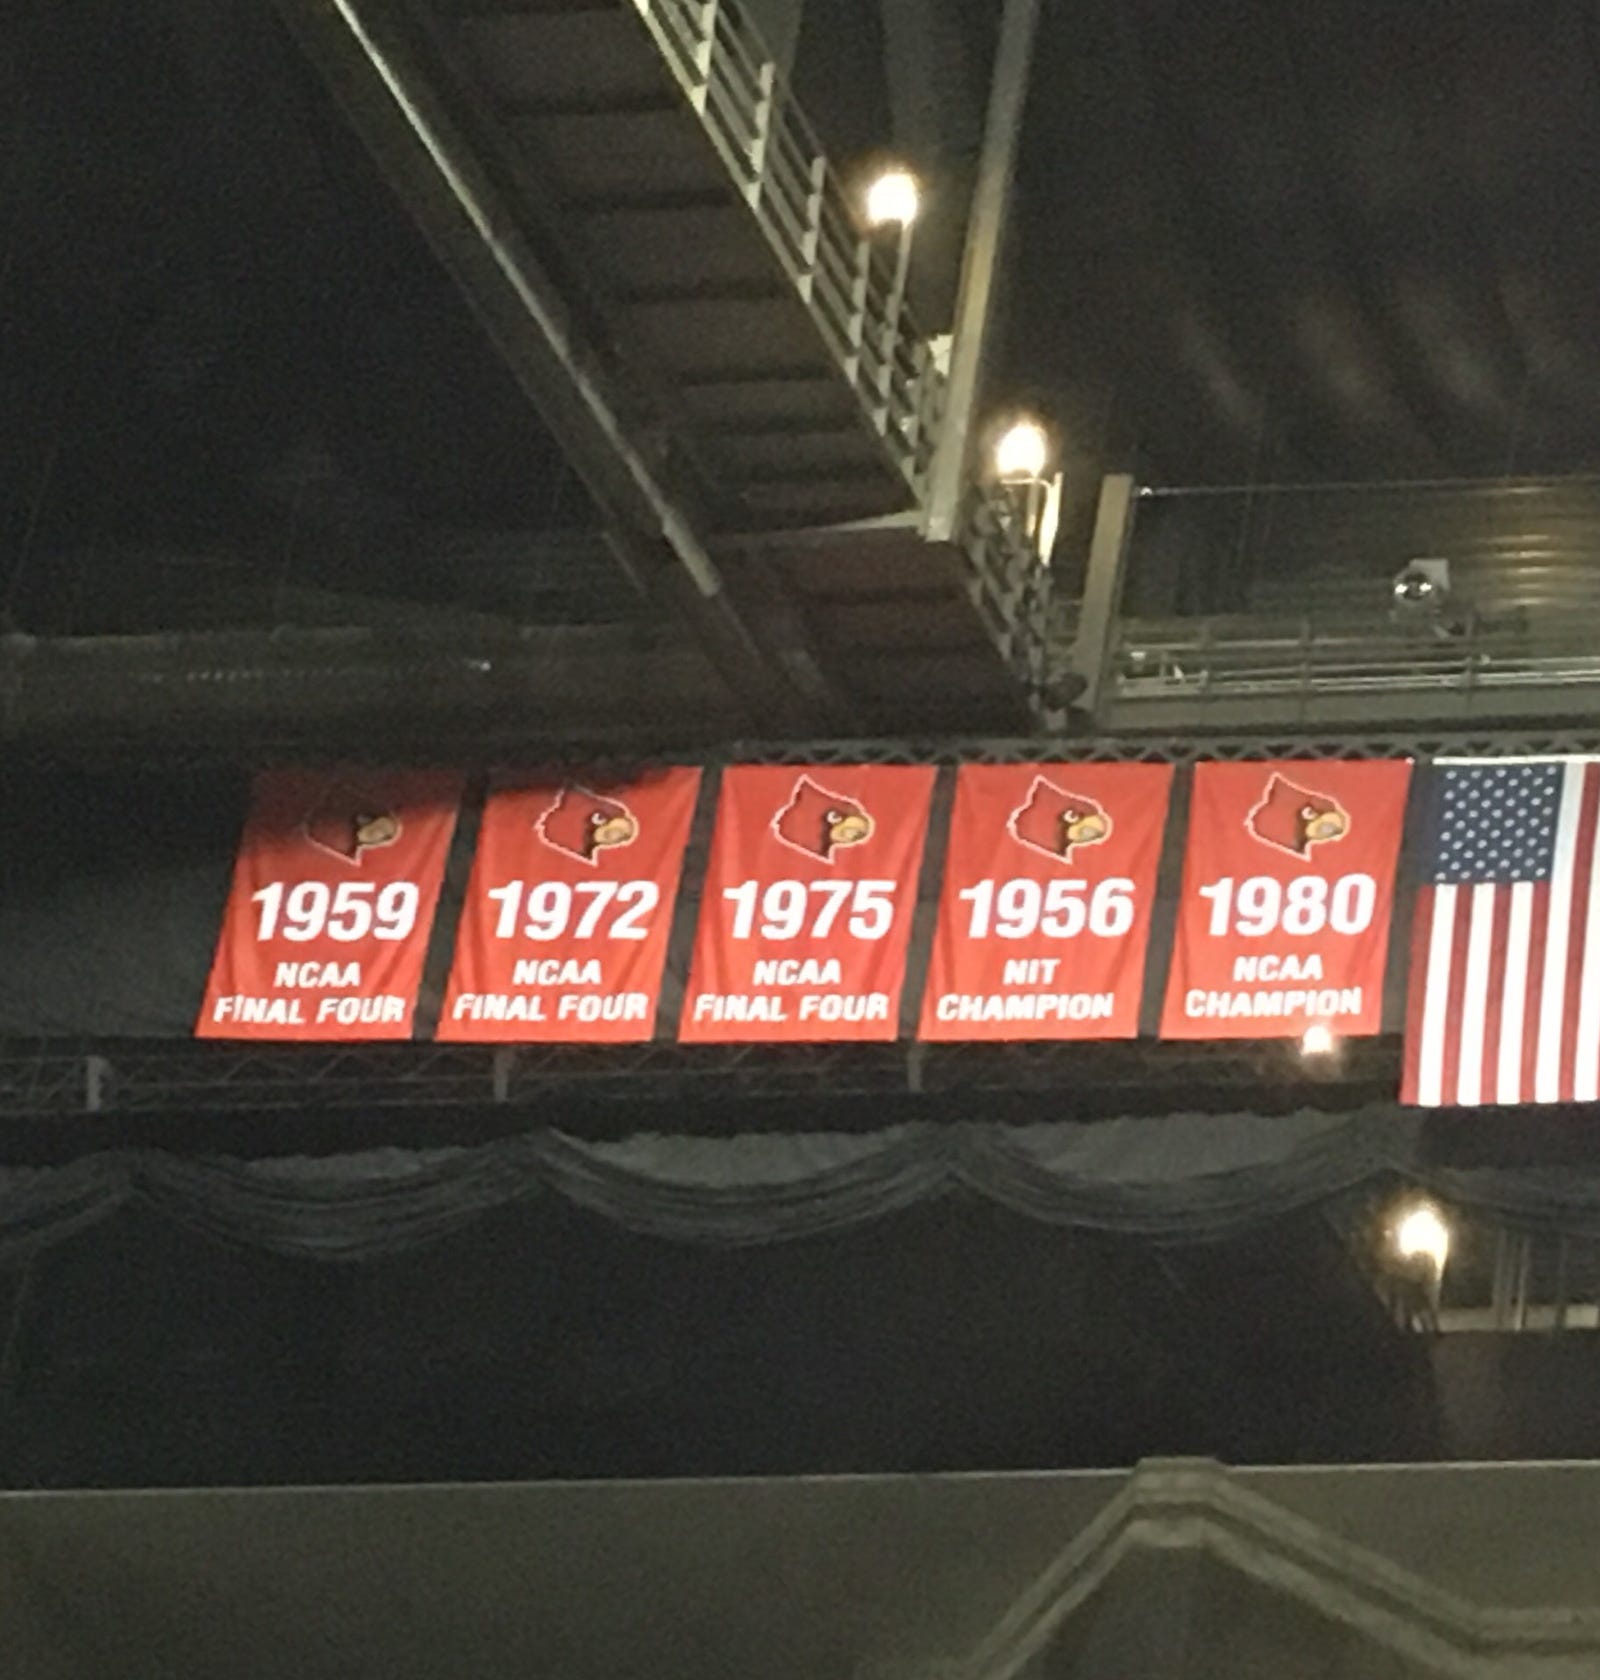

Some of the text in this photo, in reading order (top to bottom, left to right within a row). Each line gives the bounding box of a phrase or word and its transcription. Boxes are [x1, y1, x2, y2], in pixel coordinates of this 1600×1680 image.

[252, 881, 420, 942] 1959
[487, 880, 659, 941] 1972
[722, 879, 897, 941] 1975
[959, 877, 1136, 939] 1956
[1199, 873, 1377, 937] 1980
[274, 960, 361, 989] NCAA
[512, 959, 602, 986] NCAA
[752, 958, 841, 986] NCAA
[1002, 958, 1061, 985] NIT
[1232, 953, 1323, 983] NCAA
[213, 994, 406, 1025] FINAL FOUR
[452, 992, 649, 1022] FINAL FOUR
[693, 992, 889, 1022] FINAL FOUR
[936, 992, 1114, 1022] CHAMPION
[1185, 986, 1362, 1018] CHAMPION
